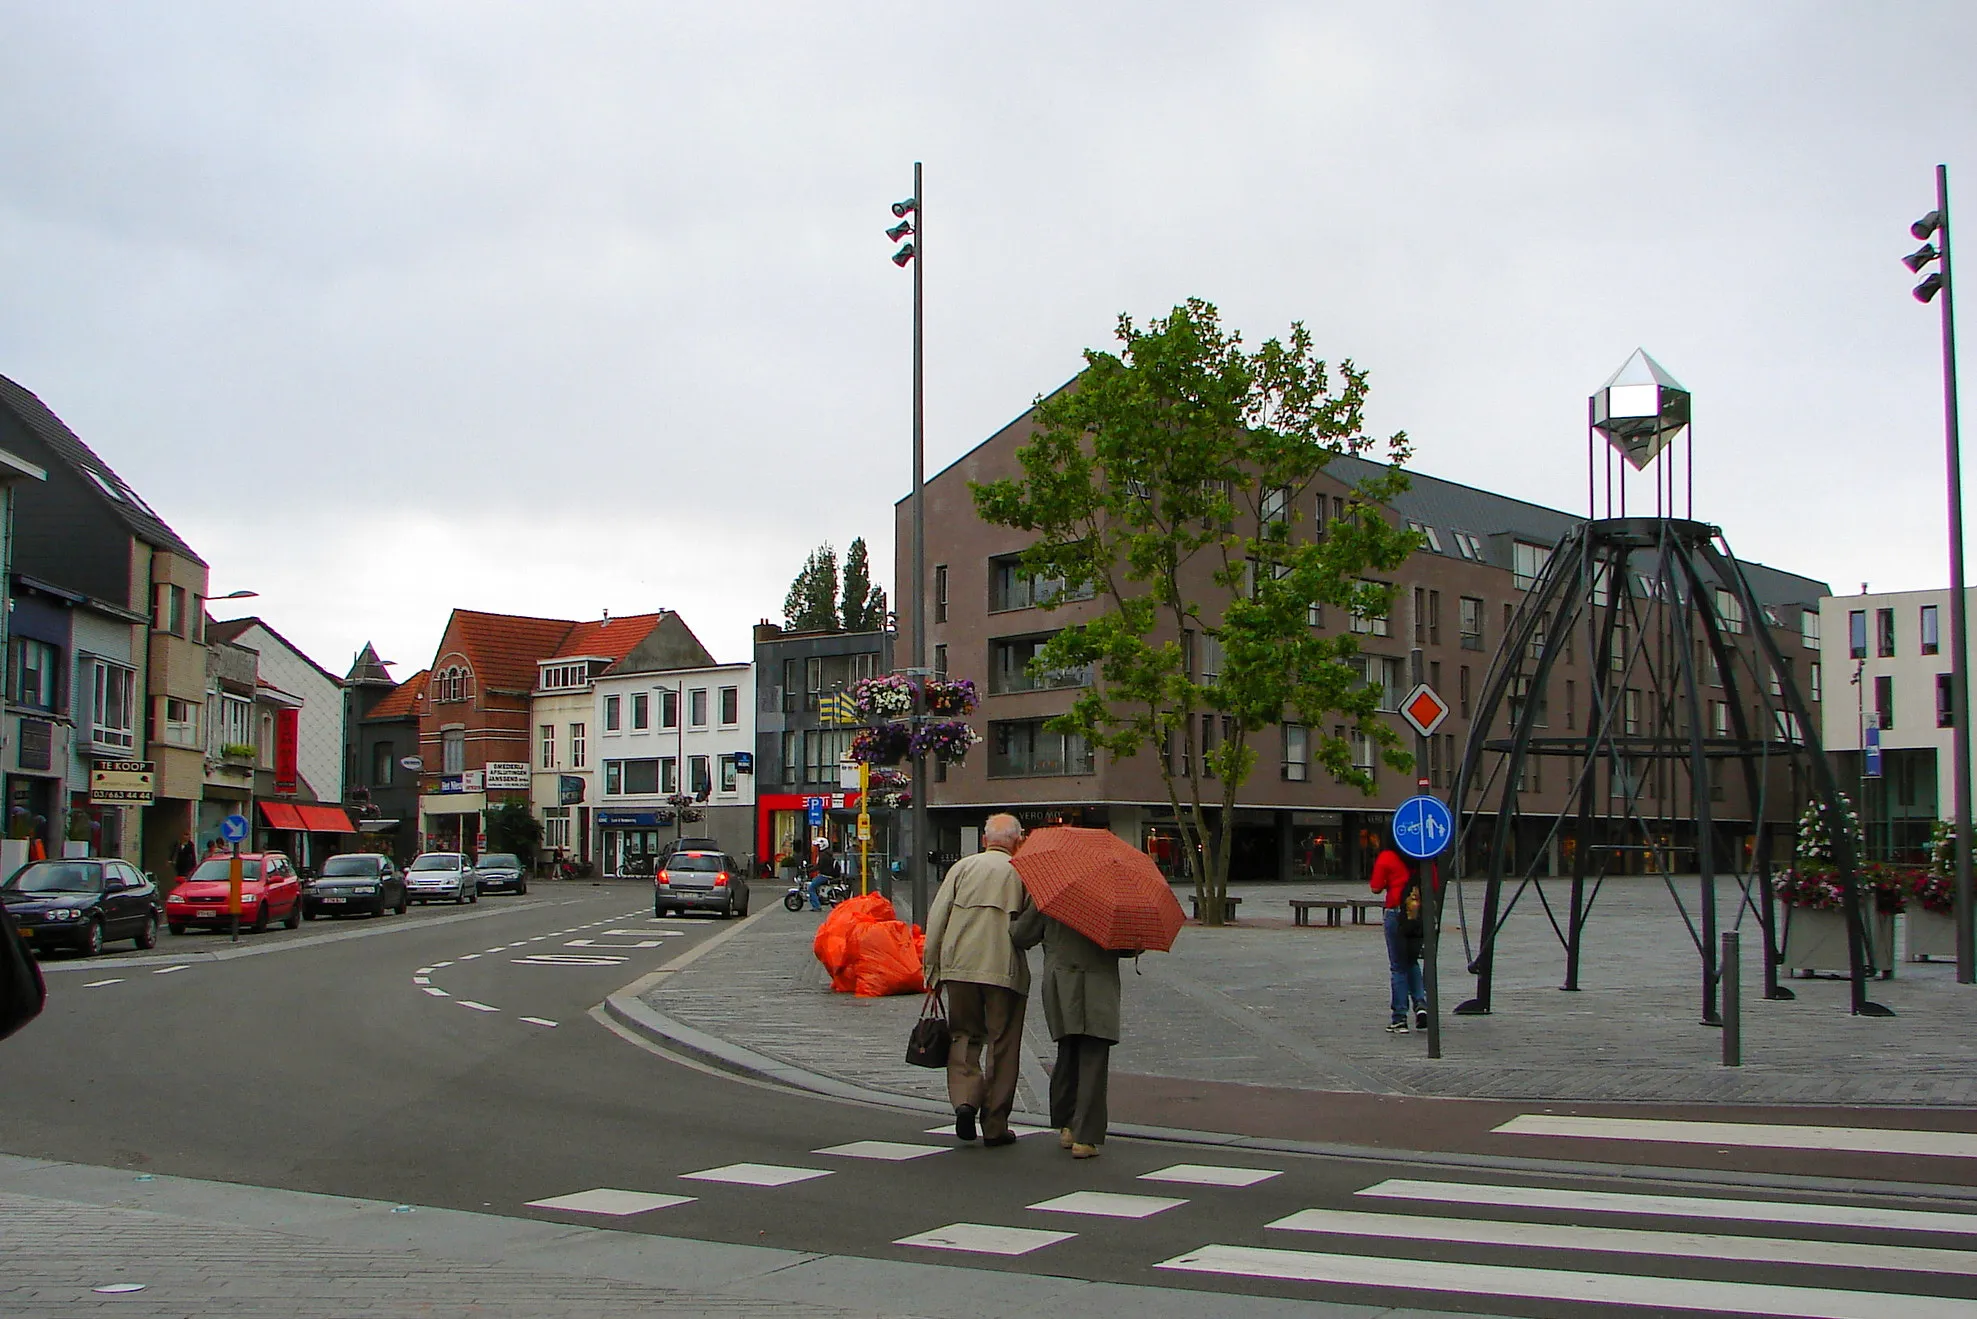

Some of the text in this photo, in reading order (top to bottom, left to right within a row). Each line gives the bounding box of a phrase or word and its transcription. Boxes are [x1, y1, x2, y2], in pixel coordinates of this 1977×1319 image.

[115, 762, 146, 771] KOOP
[811, 799, 819, 810] P
[1018, 811, 1044, 820] VERO
